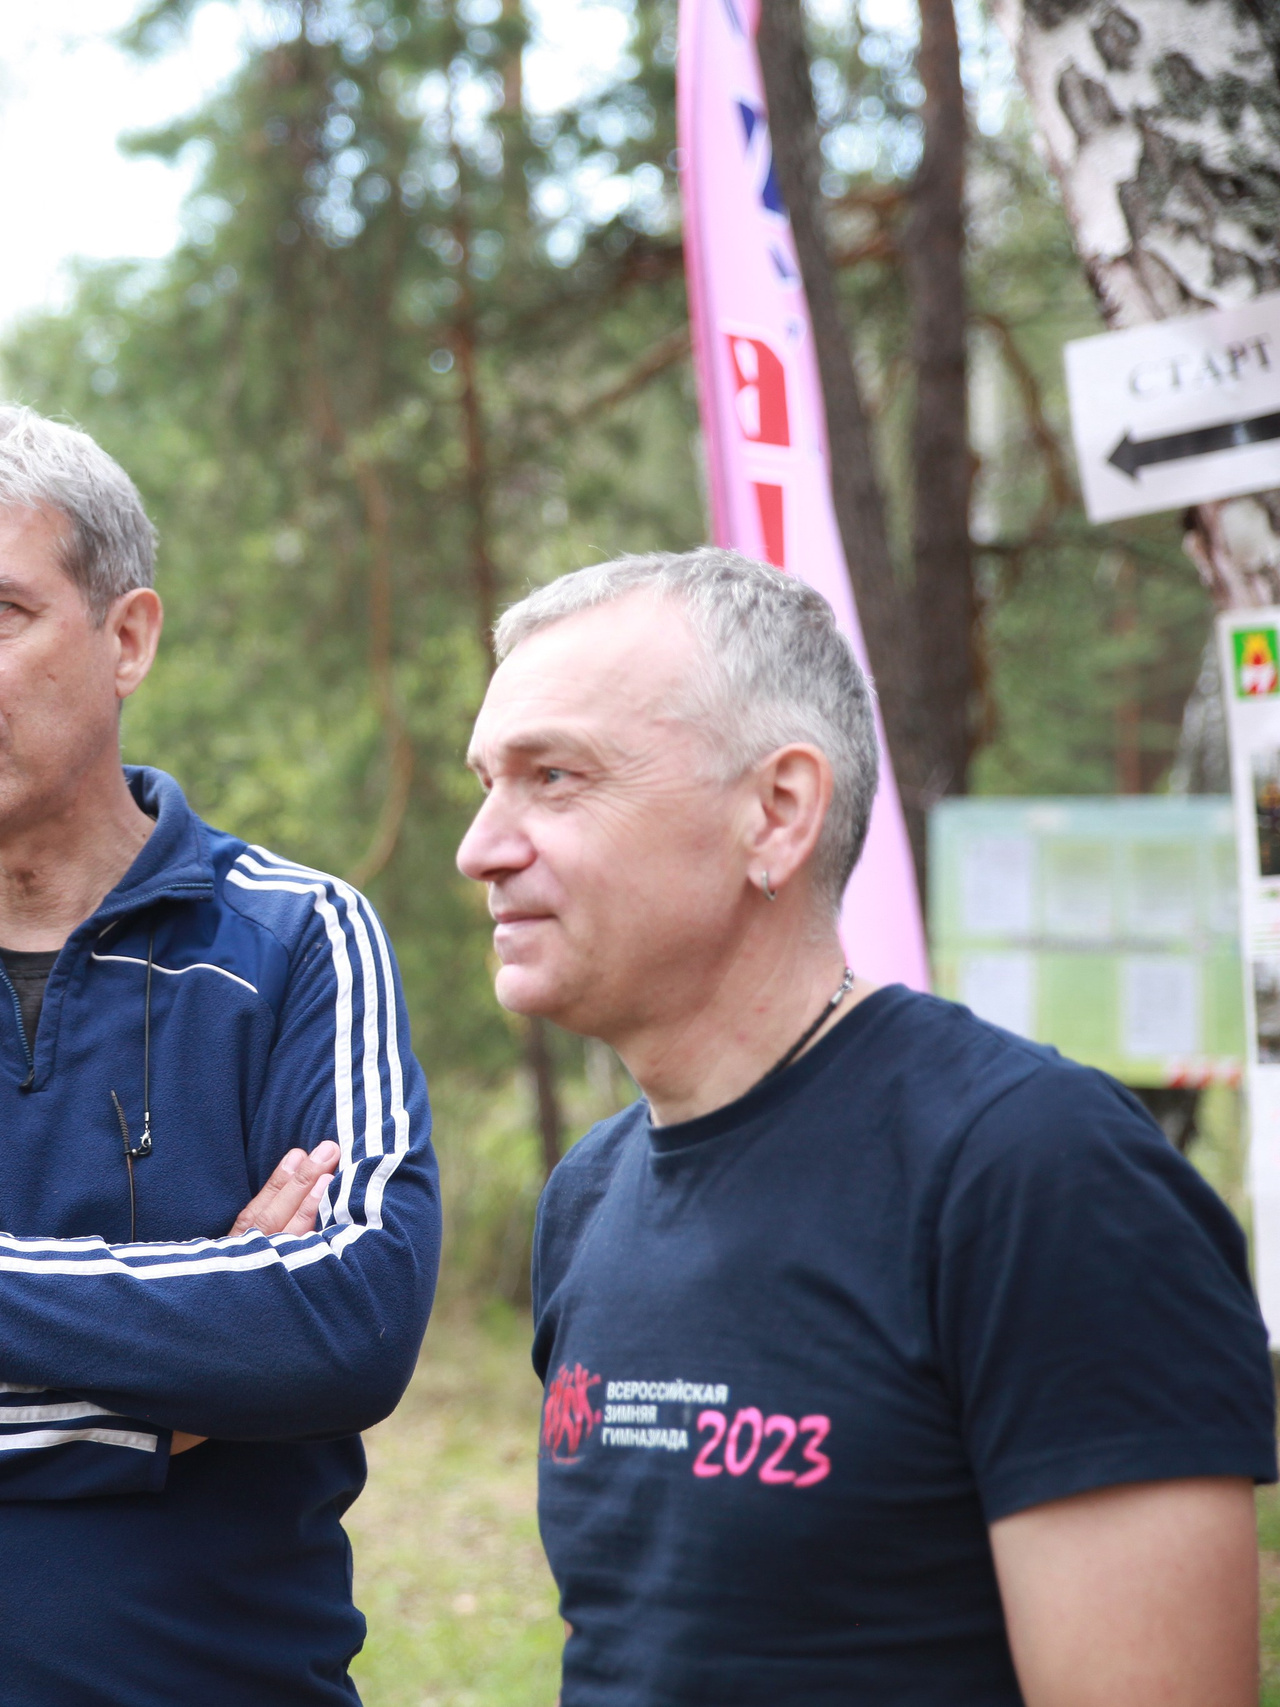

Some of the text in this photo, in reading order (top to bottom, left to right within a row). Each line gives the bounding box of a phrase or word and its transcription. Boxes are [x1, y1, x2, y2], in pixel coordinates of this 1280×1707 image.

[606, 1378, 729, 1405] ВСЕРОССИЙСКАЯ
[604, 1404, 658, 1424] ЗИМНЯЯ
[602, 1427, 689, 1451] ГИМНАЗИАДА
[692, 1406, 832, 1488] 2023
